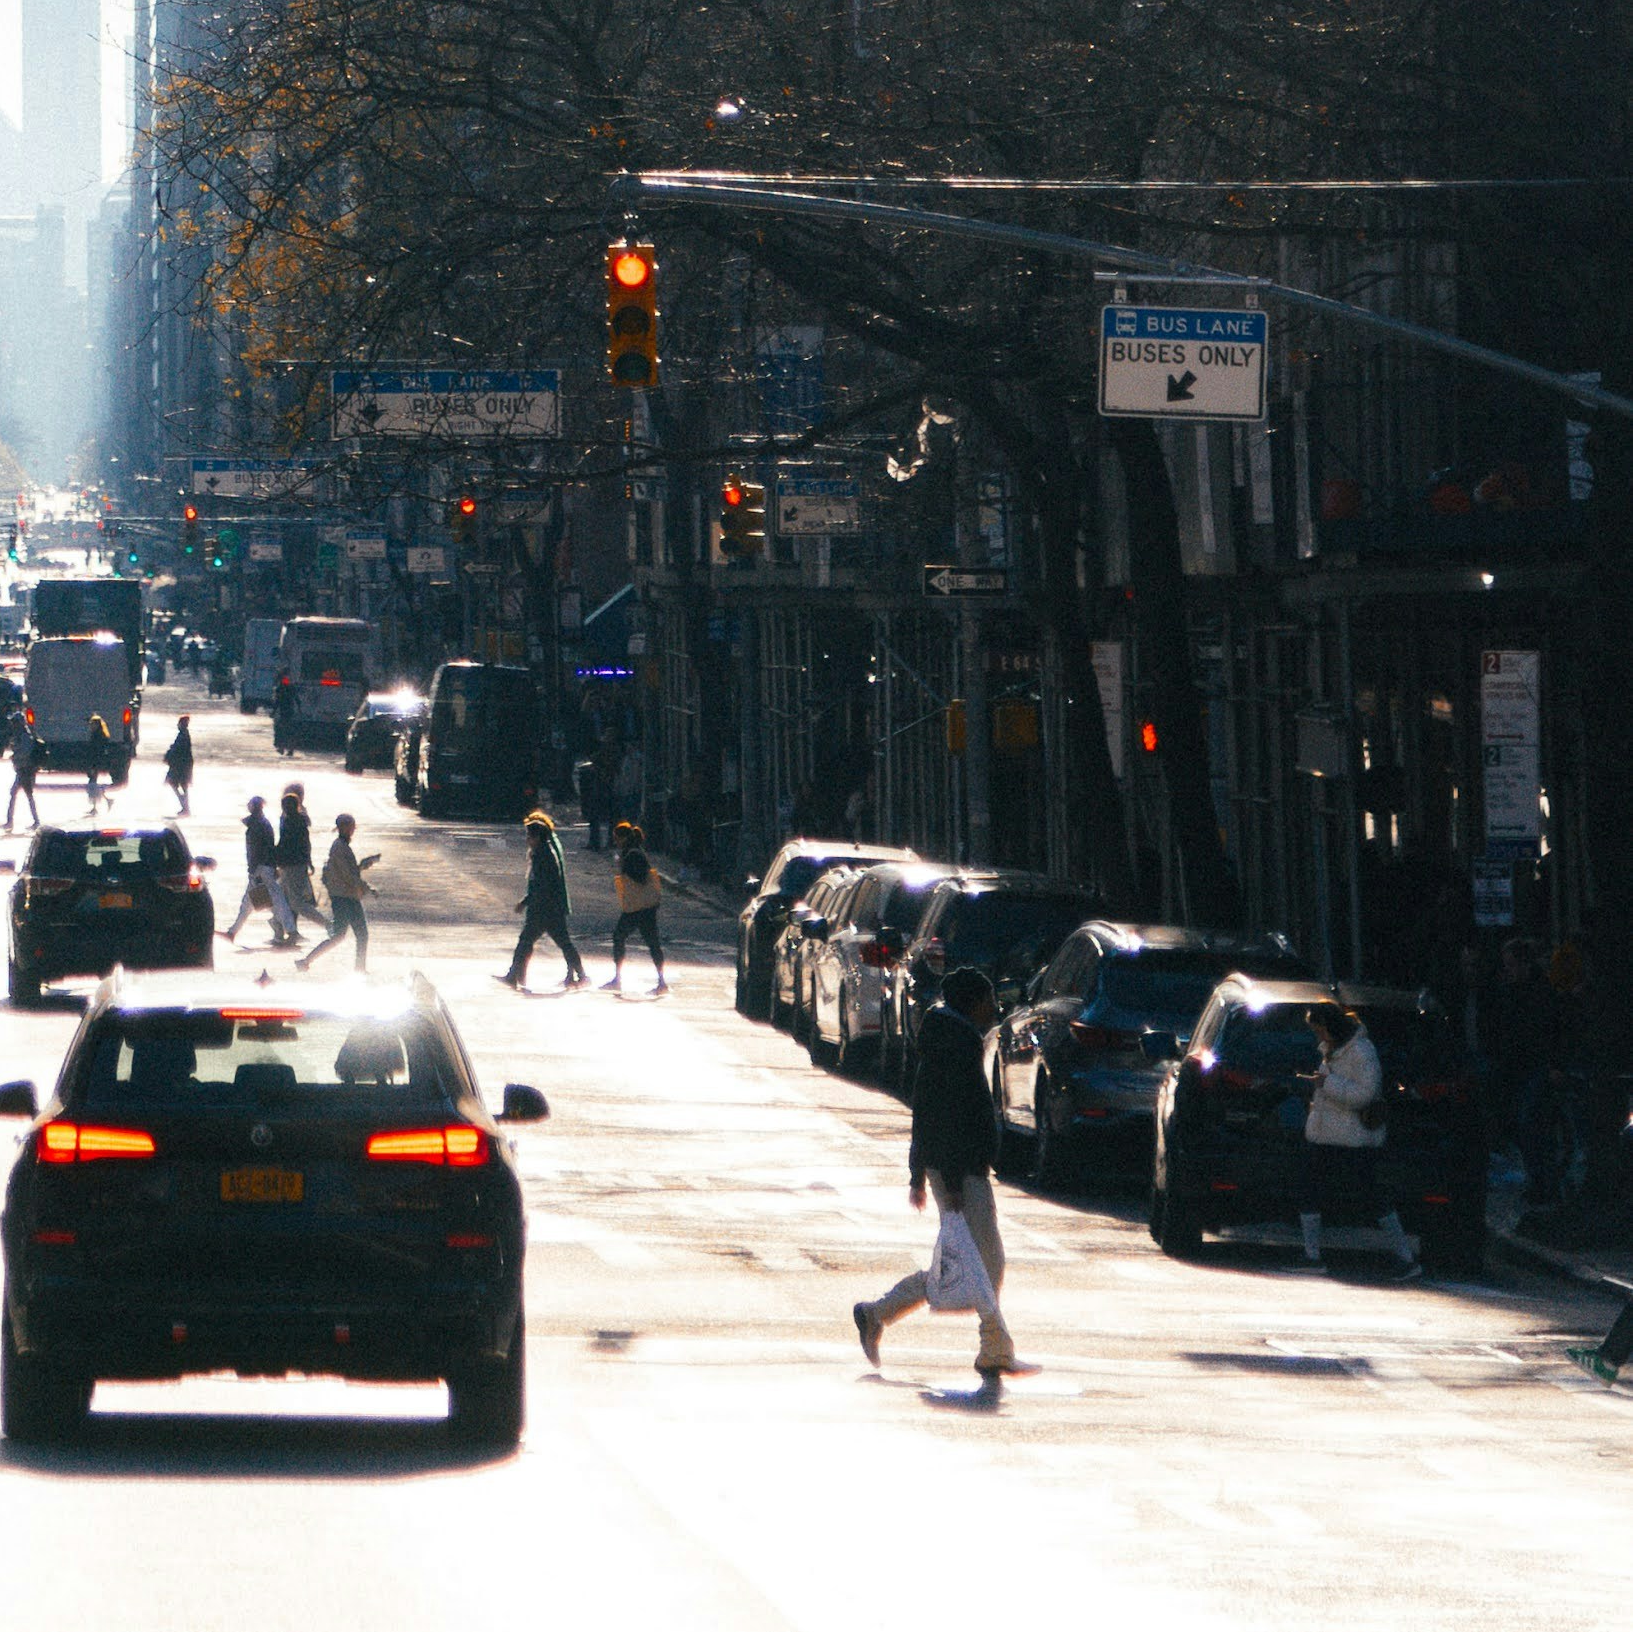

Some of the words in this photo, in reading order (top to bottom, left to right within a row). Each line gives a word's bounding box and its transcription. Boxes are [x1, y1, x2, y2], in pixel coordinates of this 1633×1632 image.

[1146, 315, 1188, 334] BUS
[1195, 318, 1254, 336] LANE
[1111, 341, 1186, 364] BUSES
[1198, 344, 1256, 367] ONLY
[412, 397, 477, 415] BUSES
[485, 396, 536, 415] ONLY
[937, 576, 964, 588] ONE
[1486, 654, 1498, 672] 2
[1488, 746, 1499, 766] 2
